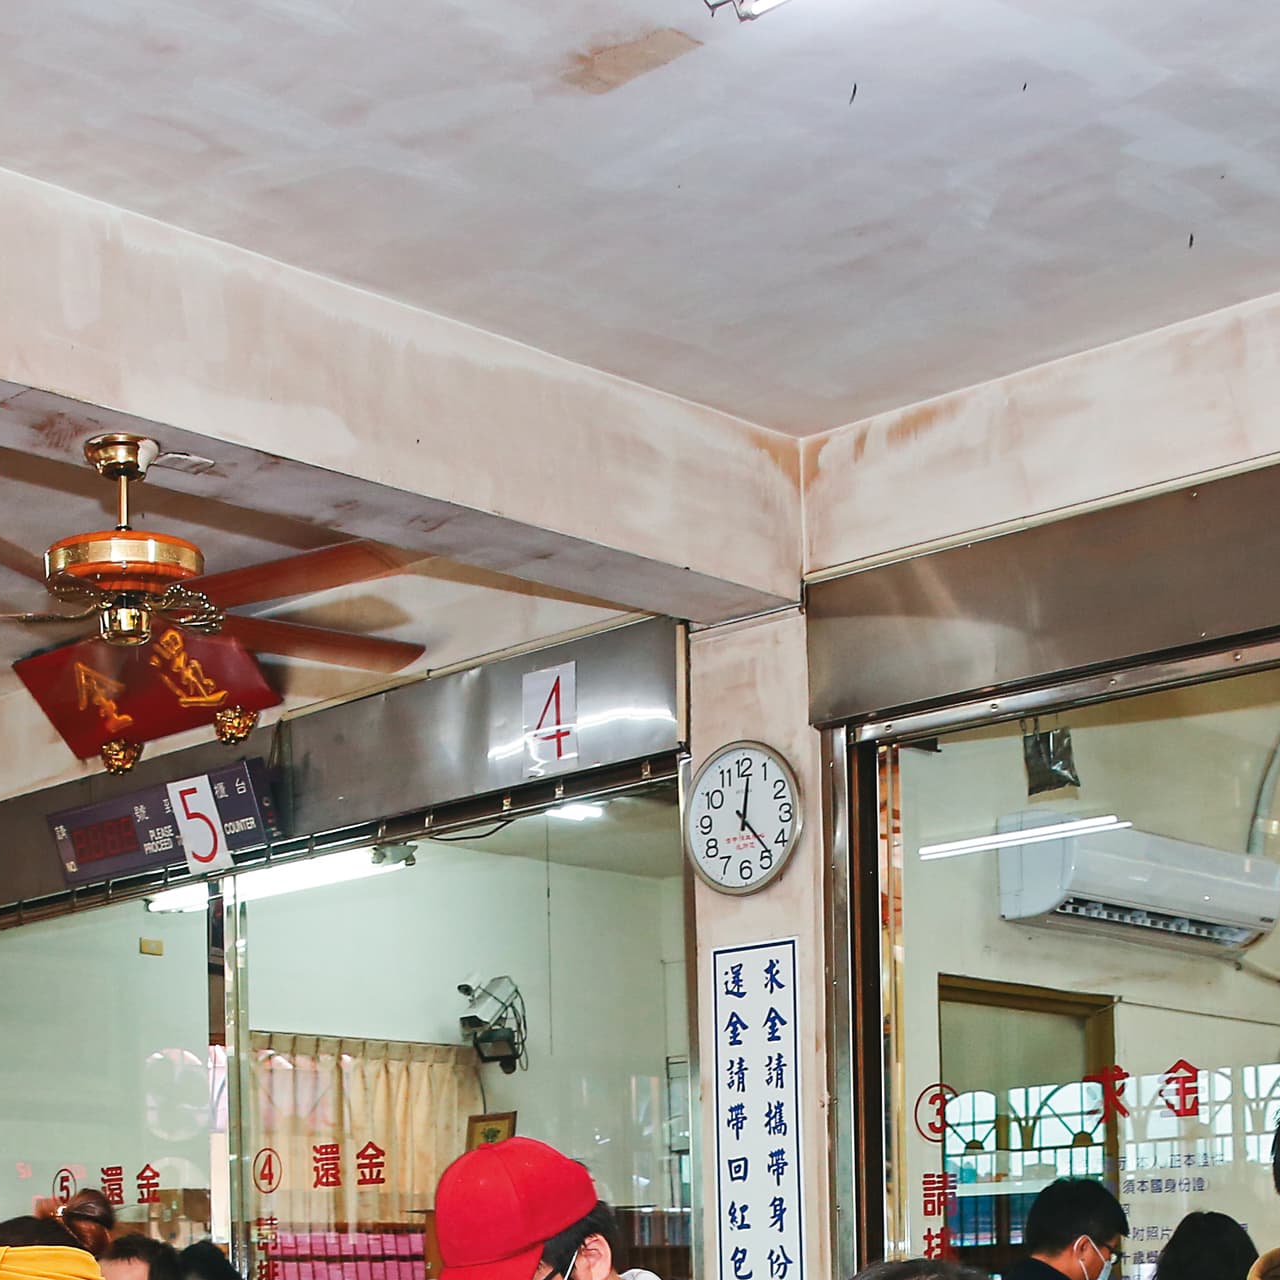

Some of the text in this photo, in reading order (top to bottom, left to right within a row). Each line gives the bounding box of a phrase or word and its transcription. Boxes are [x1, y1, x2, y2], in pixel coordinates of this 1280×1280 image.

[535, 676, 570, 758] 4
[720, 768, 732, 788] 11
[736, 758, 753, 778] 12
[705, 790, 724, 810] 10
[773, 780, 786, 800] 2
[779, 803, 792, 822] 3
[149, 825, 174, 841] PLEASE
[224, 816, 257, 836] COUNTER
[179, 787, 218, 863] 5
[700, 815, 713, 835] 9
[144, 838, 173, 855] PROCEED
[774, 828, 788, 847] 4
[706, 838, 719, 858] 8
[720, 856, 732, 875] 7
[740, 860, 753, 880] 6
[760, 850, 773, 870] 5
[1084, 1058, 1200, 1124] 求金
[313, 1141, 386, 1188] 還金
[101, 1163, 161, 1205] 還金
